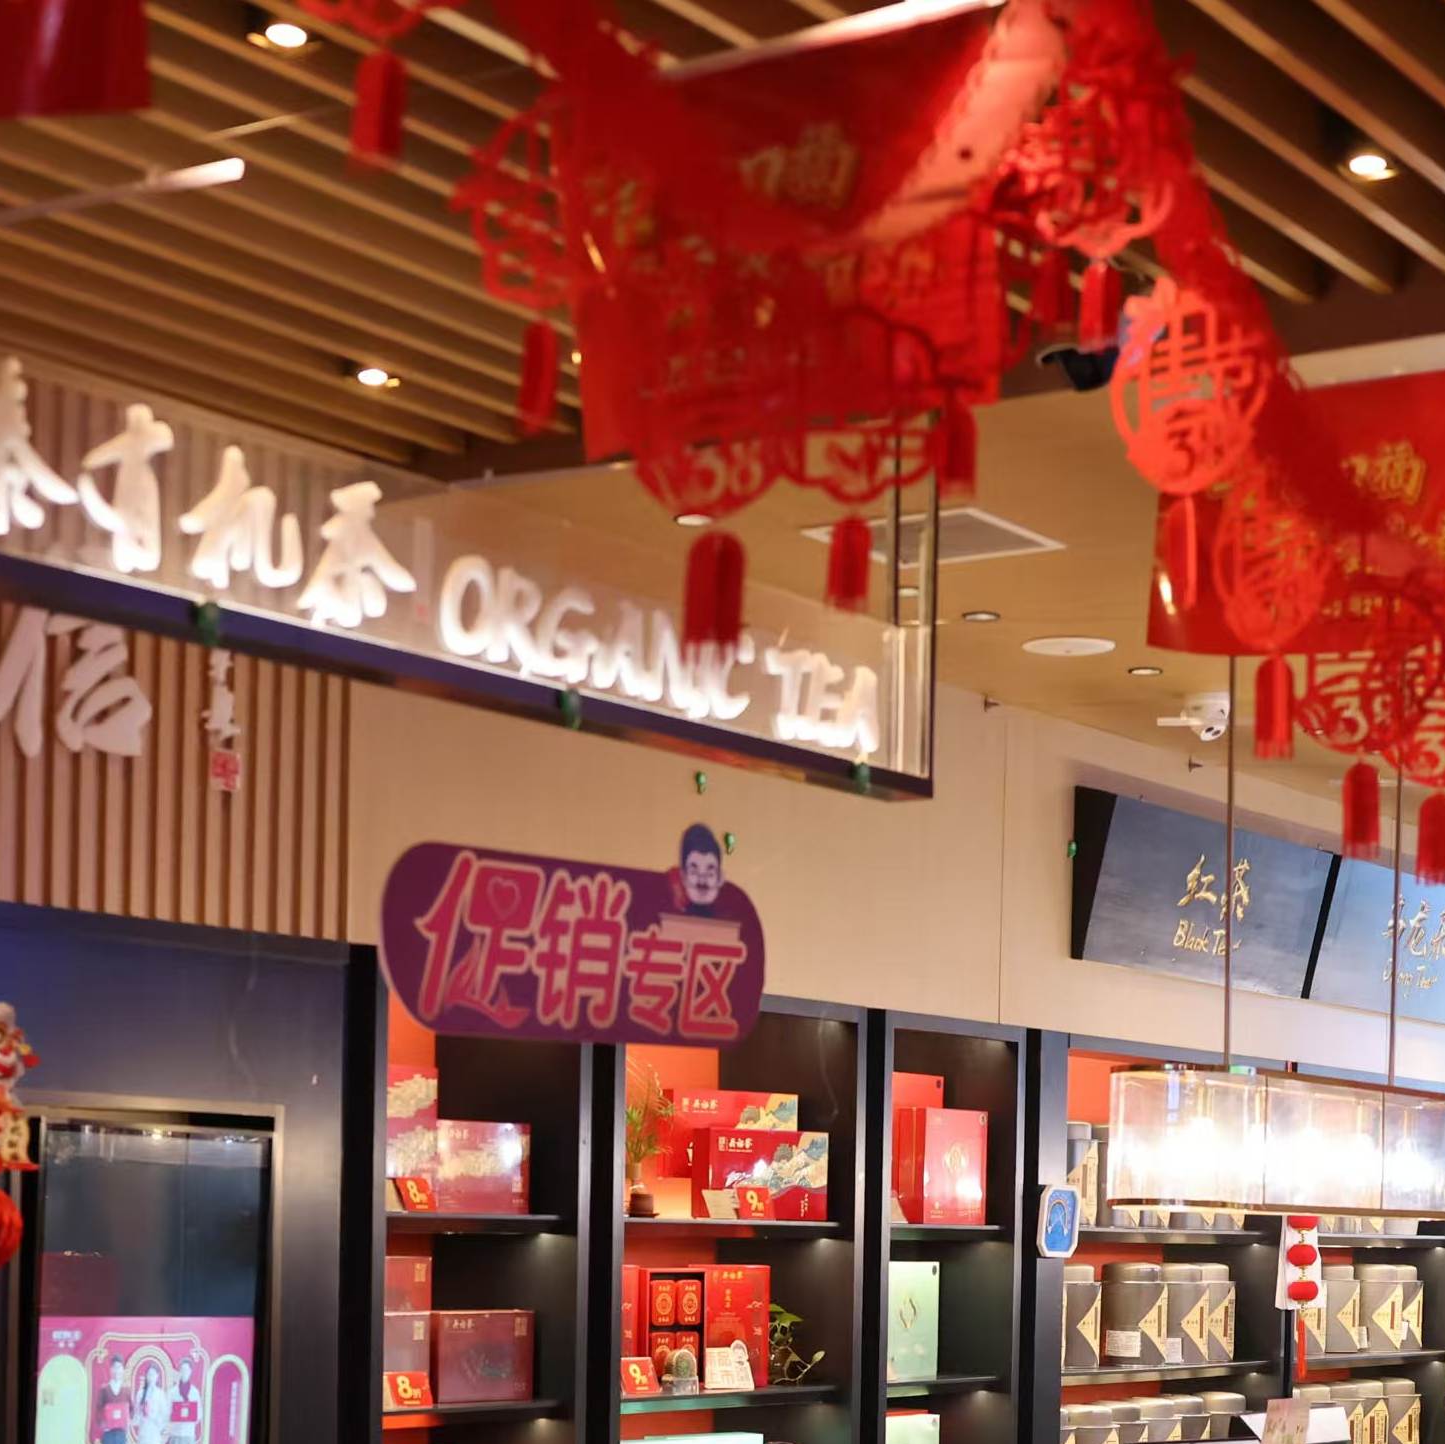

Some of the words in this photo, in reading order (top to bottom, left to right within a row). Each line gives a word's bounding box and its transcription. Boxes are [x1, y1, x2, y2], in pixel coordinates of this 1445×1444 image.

[440, 555, 755, 720] ORGANIC
[765, 644, 880, 754] TEA
[414, 850, 748, 1038] 促销专区
[1173, 919, 1210, 953] Black
